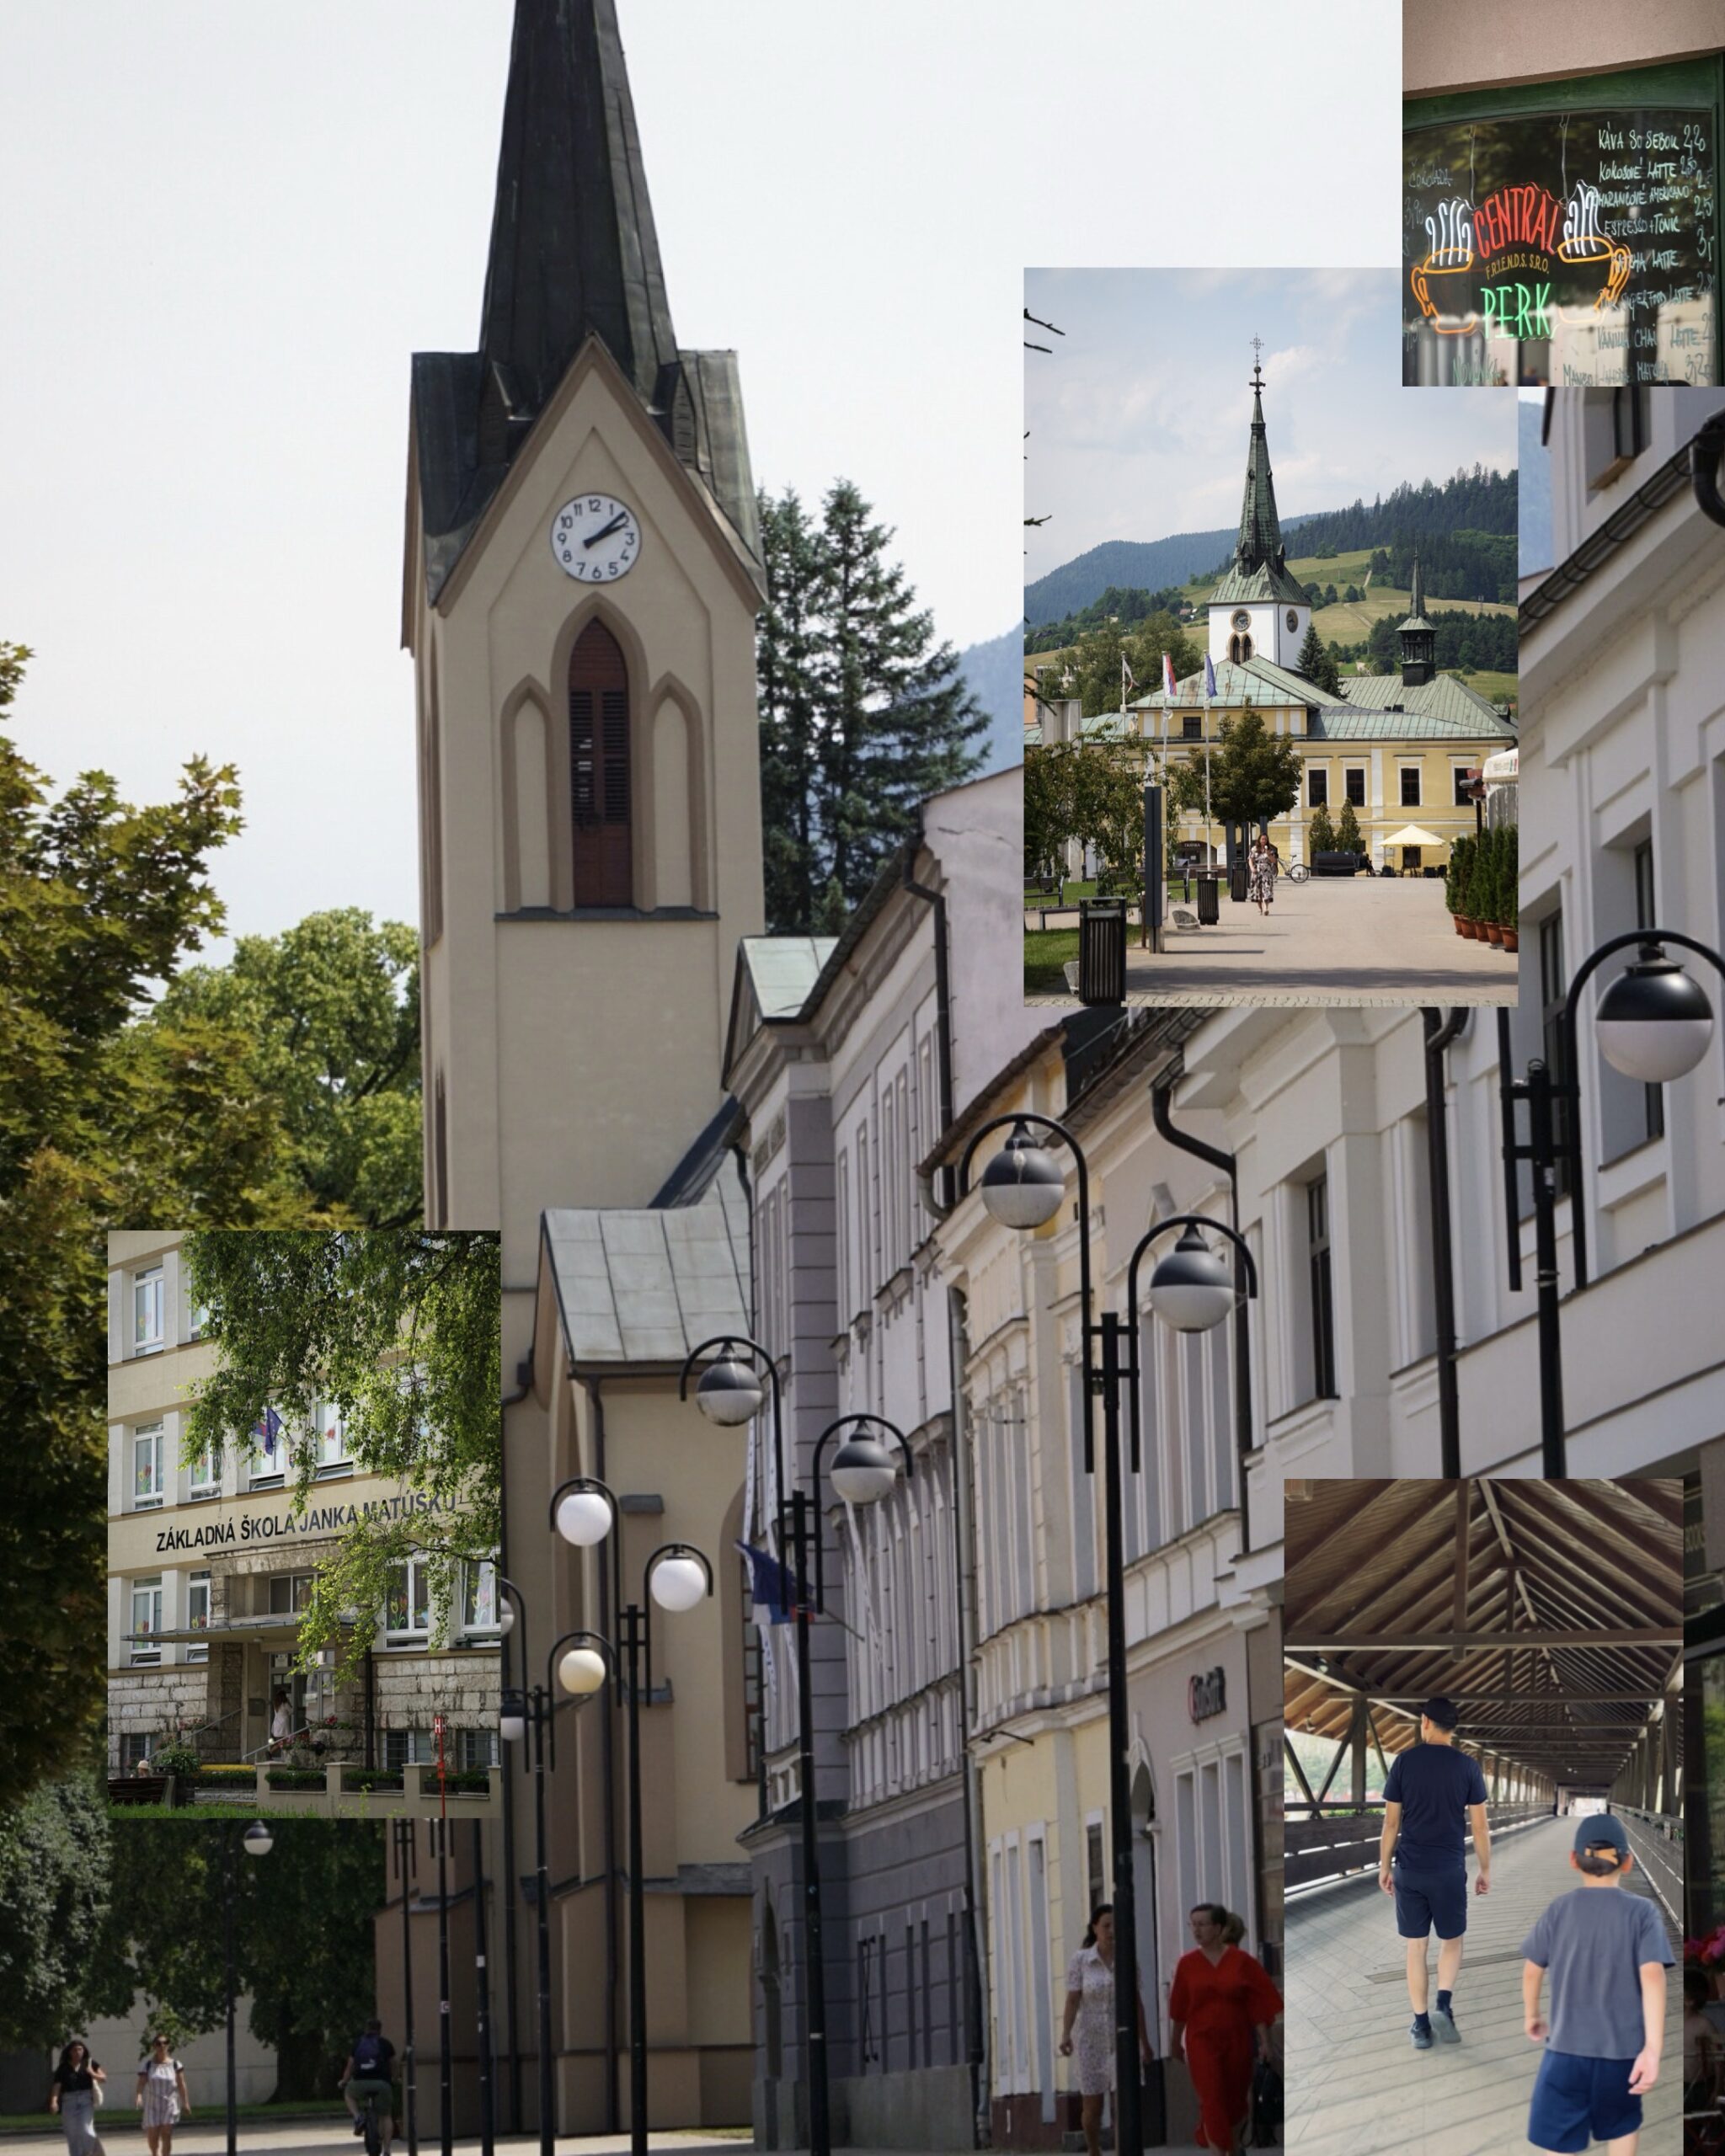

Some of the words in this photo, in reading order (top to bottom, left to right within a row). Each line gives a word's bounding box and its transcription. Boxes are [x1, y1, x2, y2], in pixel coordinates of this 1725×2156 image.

[1648, 161, 1677, 180] LATTE
[1473, 186, 1559, 259] CENTRAL
[1529, 254, 1551, 275] S.R.O.
[1652, 248, 1680, 270] LATTE
[1480, 282, 1551, 339] PERK
[574, 503, 583, 516] 11
[588, 499, 601, 513] 12
[609, 504, 614, 516] 1
[561, 515, 574, 529] 10
[557, 532, 567, 546] 9
[625, 532, 635, 547] 3
[562, 549, 573, 563] 8
[620, 548, 629, 563] 4
[576, 562, 586, 576] 7
[592, 565, 602, 579] 6
[608, 561, 619, 575] 5
[156, 1517, 236, 1552] ZÁKLADNÁ
[240, 1514, 296, 1540] ŠKOLA
[299, 1504, 359, 1532] JANKA
